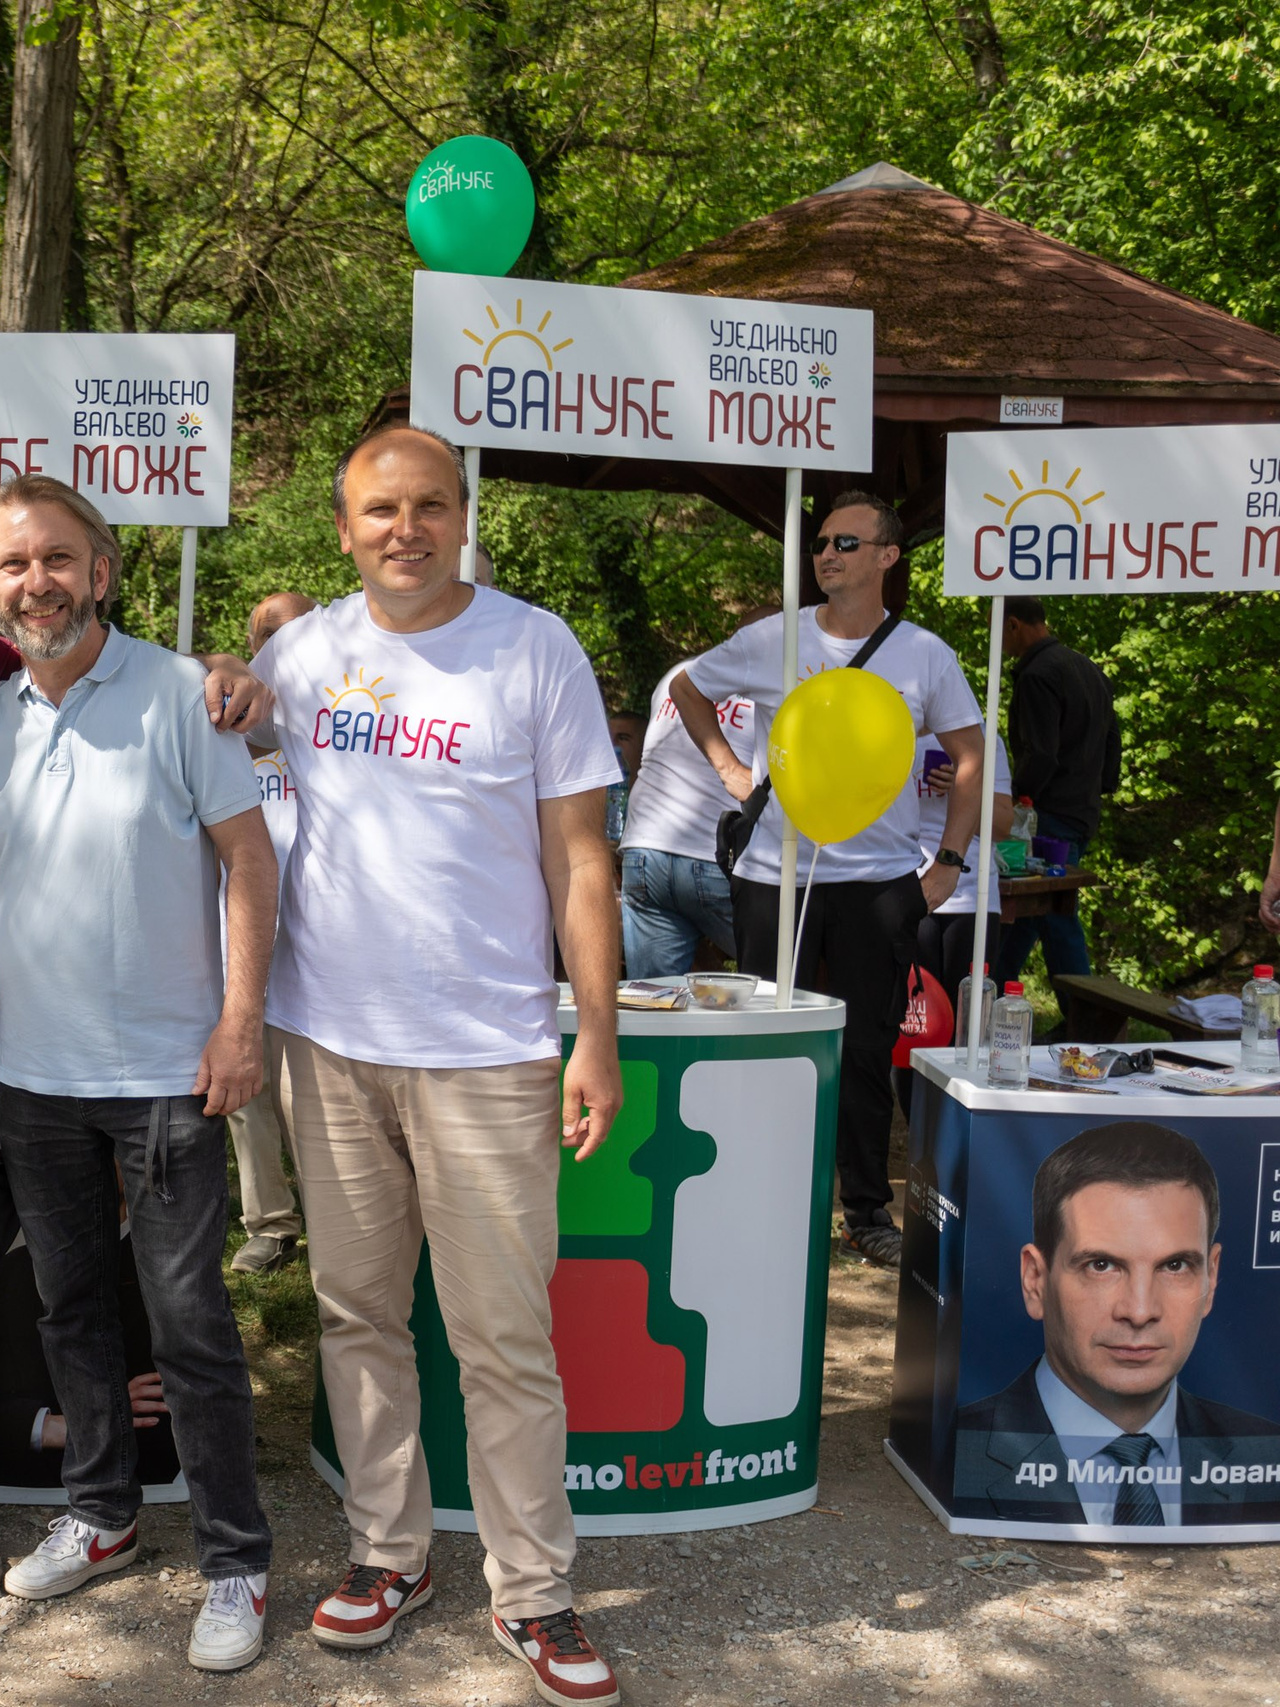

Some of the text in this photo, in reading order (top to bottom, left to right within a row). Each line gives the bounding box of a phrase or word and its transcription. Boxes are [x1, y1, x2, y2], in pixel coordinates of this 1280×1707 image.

[419, 171, 494, 203] СВАНУЋЕ
[710, 319, 837, 356] УЈЕДИЊЕНО
[709, 354, 798, 387] ВАЉЕВО
[75, 379, 210, 406] УЈЕДИЊЕНО
[453, 364, 675, 441] СВАНУЋЕ
[1004, 402, 1058, 418] СВАНУЋЕ
[74, 411, 166, 438] ВАЉЕВО
[708, 389, 837, 451] МОЖЕ
[73, 444, 207, 496] МОЖЕ
[974, 521, 1218, 582] СВАНУЋЕ
[312, 708, 470, 765] СВАНУЋЕ
[565, 1441, 797, 1491] nolevifront
[1015, 1462, 1058, 1488] др
[1067, 1458, 1183, 1485] Милош
